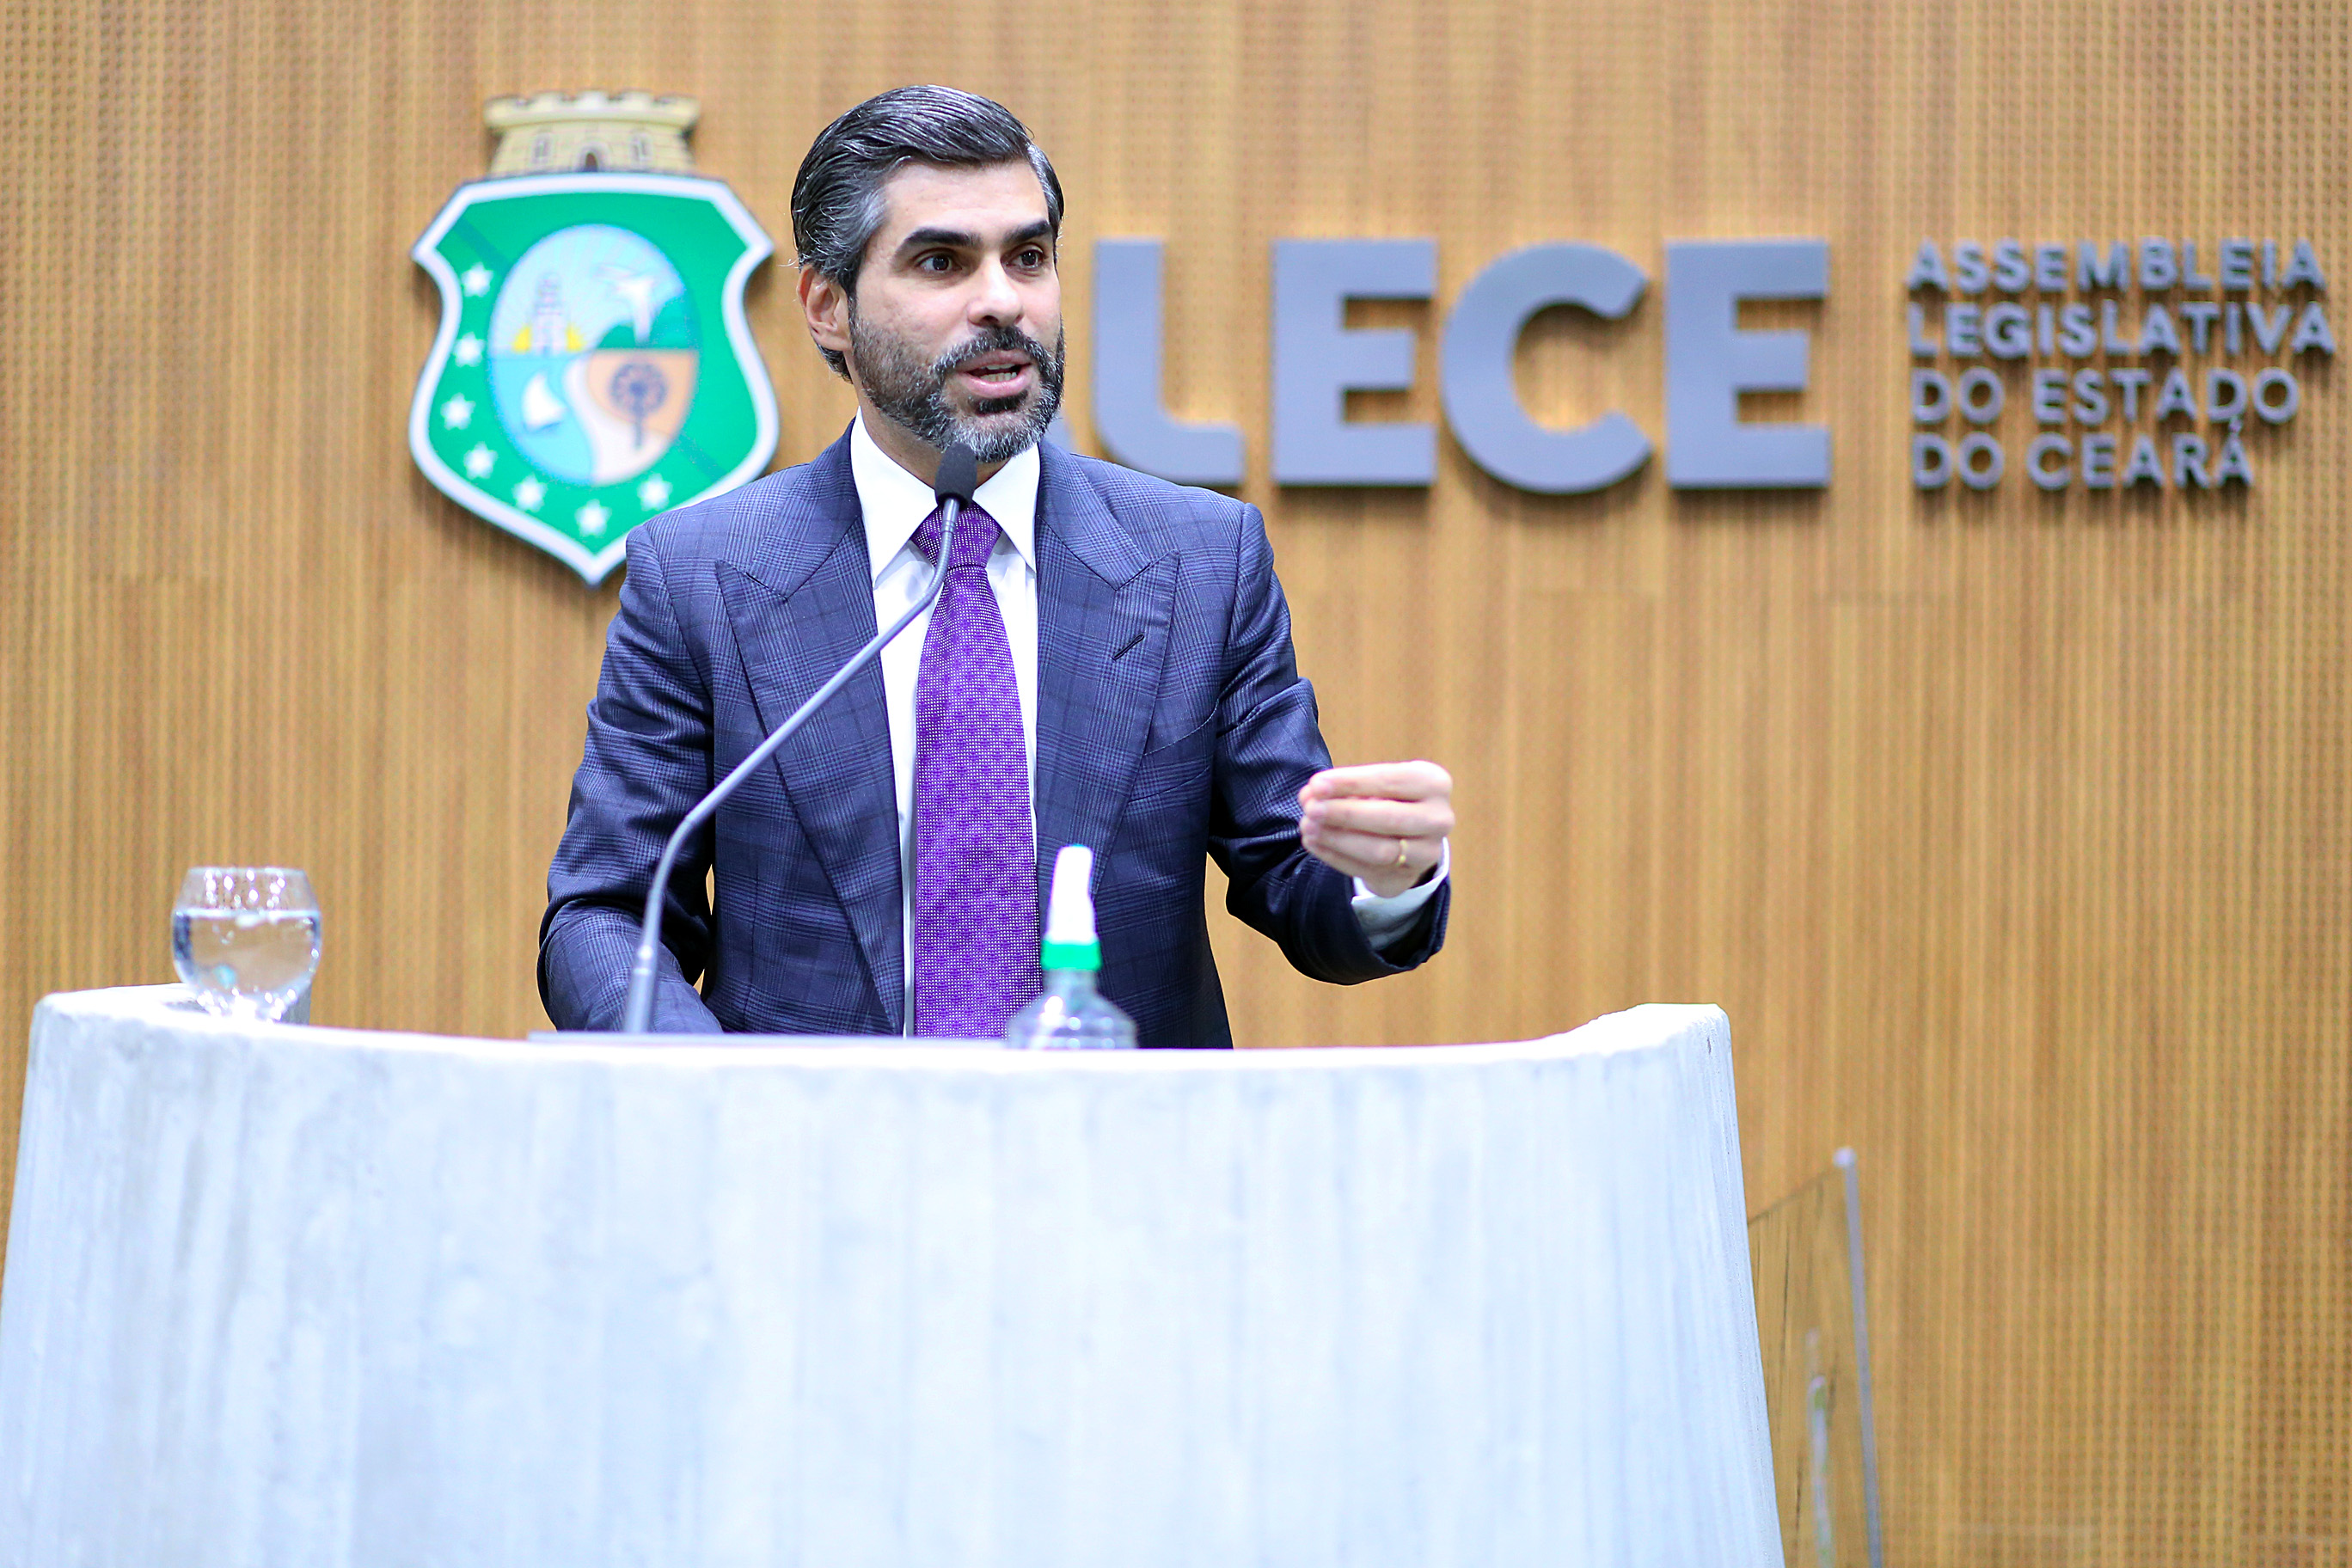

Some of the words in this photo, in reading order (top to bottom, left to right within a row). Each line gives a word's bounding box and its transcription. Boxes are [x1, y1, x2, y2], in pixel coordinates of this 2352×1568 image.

[1906, 236, 2326, 293] ASSEMBLEIA
[1906, 300, 2335, 358] LEGISLATIVA
[1040, 238, 1831, 493] LECE
[1910, 366, 2005, 425] DO
[2032, 366, 2300, 426] ESTADO
[1911, 432, 2005, 490] DO
[2026, 418, 2253, 490] CEARÁ
